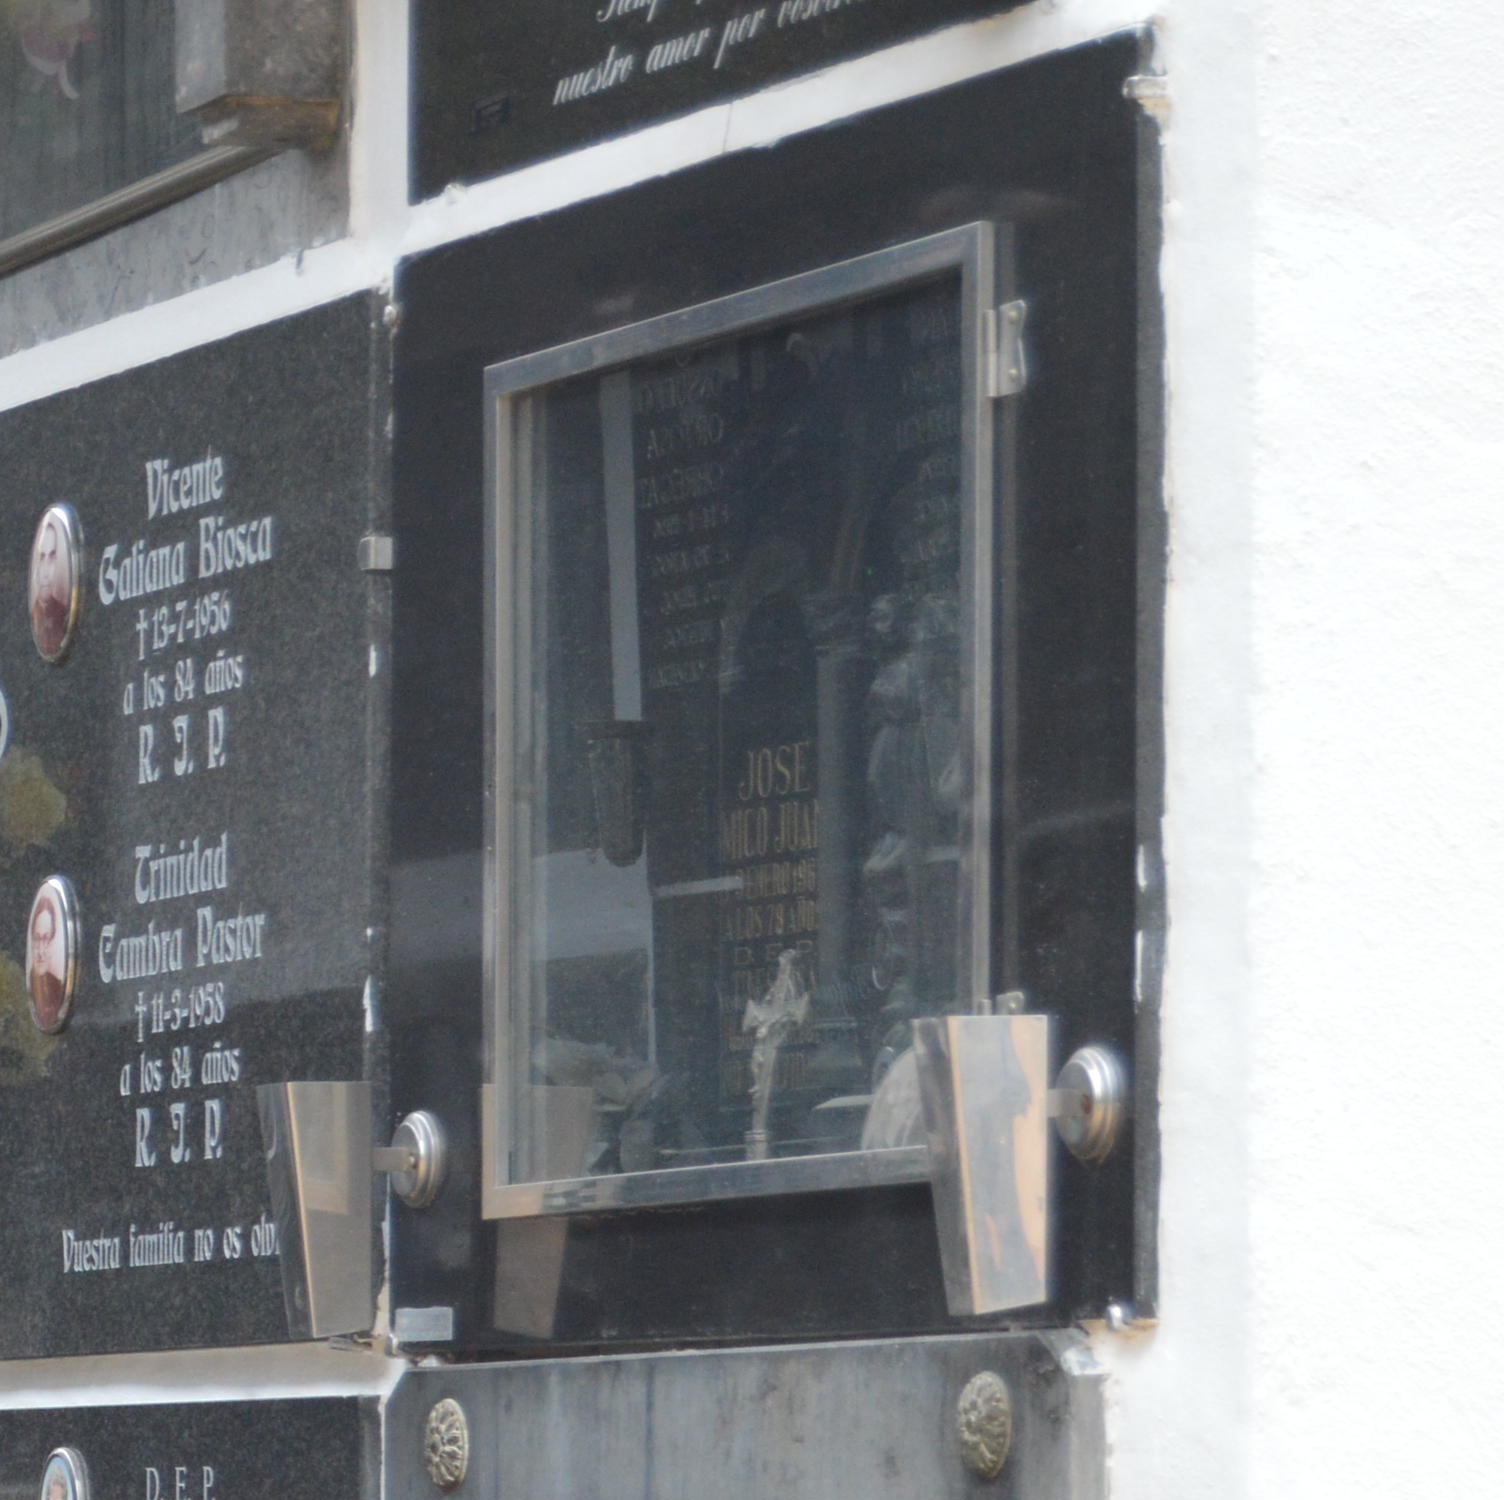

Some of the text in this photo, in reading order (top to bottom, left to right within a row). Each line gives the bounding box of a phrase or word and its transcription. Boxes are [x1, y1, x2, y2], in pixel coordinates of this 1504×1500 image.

[714, 8, 766, 69] por
[145, 446, 224, 519] Vicente
[99, 516, 273, 606] Galiana Biosca
[143, 666, 164, 710] los
[205, 650, 243, 693] años
[738, 740, 810, 801] JOSE
[135, 833, 228, 904] Trinidad
[99, 907, 265, 983] Cambra Pastor
[141, 1049, 161, 1093] los
[202, 1041, 240, 1084] años
[62, 1221, 241, 1273] Vuestra familia no os
